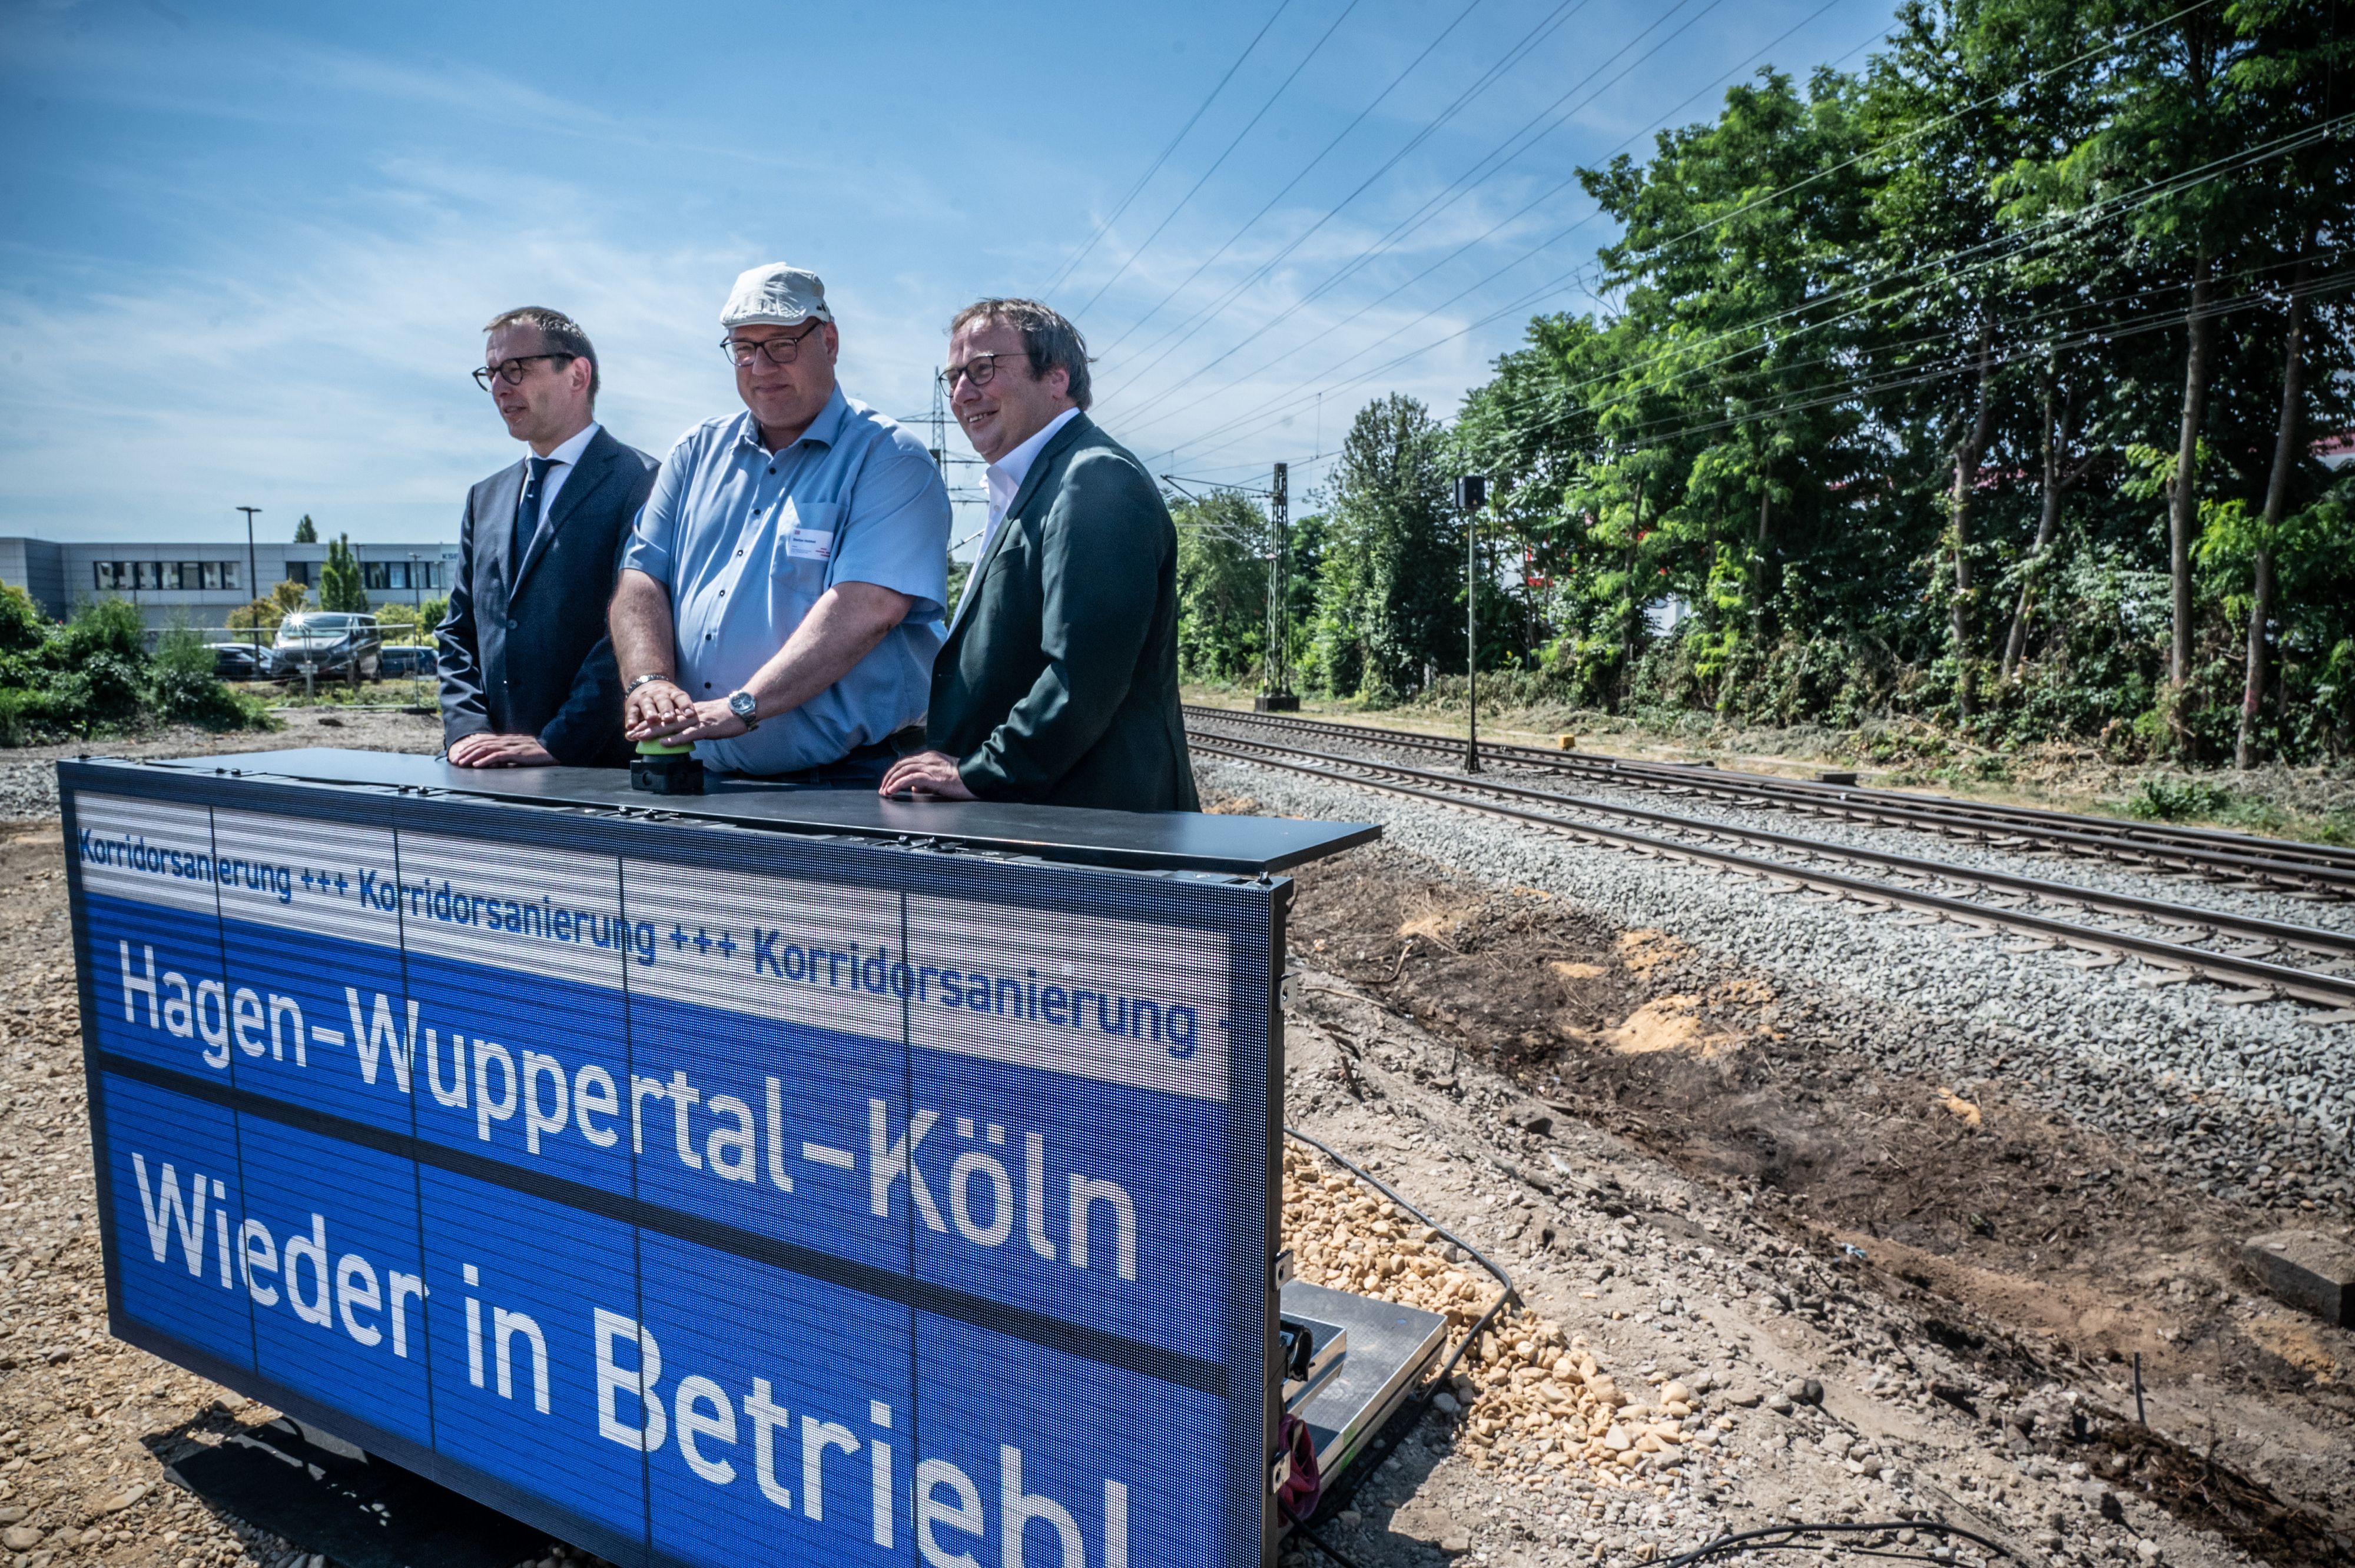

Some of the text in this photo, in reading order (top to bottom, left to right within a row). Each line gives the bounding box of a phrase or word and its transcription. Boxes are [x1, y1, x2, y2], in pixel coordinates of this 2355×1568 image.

[79, 829, 1195, 1058] Korridorsanierung +++ Korridorsanierung +++ Korridorsanierung
[132, 1152, 430, 1358] Wieder
[463, 1264, 550, 1414] in
